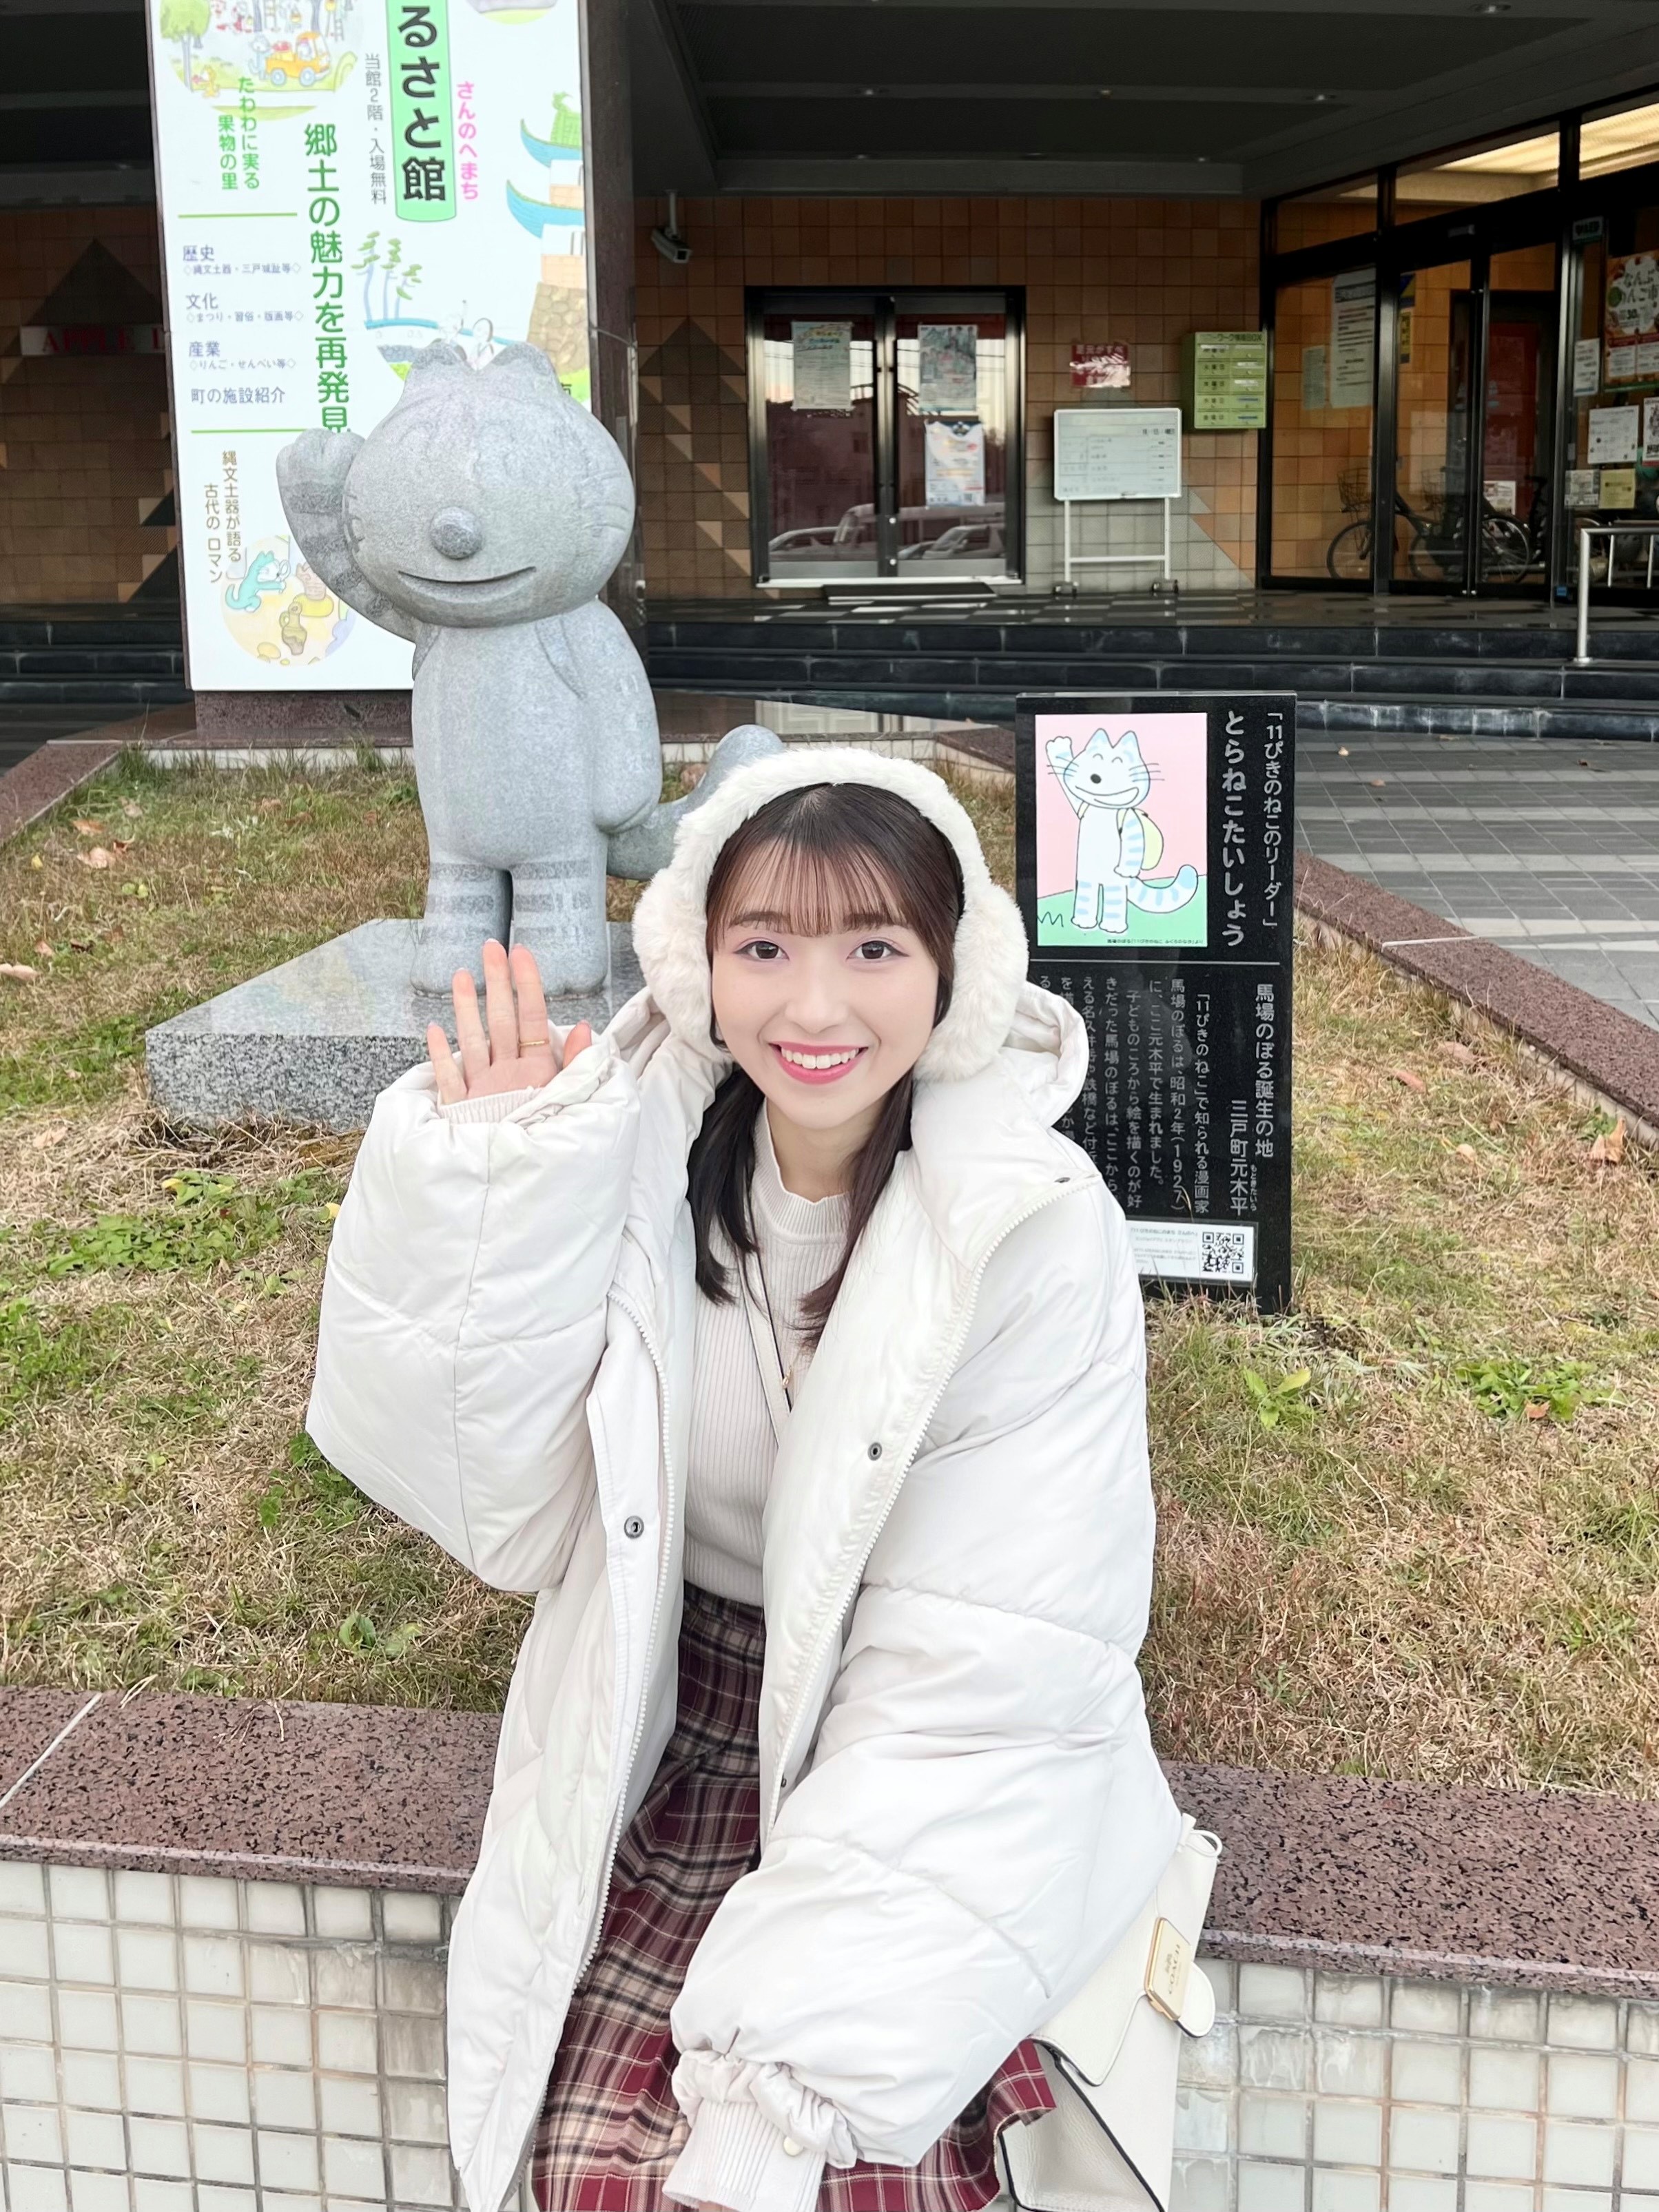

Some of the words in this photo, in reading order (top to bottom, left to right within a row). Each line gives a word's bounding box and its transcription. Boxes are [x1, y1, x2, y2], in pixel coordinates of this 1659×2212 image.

[218, 114, 238, 190] 果物の里
[238, 76, 260, 189] たわわに実る
[365, 53, 387, 205] 当館2階・入場無料
[398, 6, 446, 201] るさと館
[457, 81, 479, 200] さんのへまち
[183, 245, 215, 262] 歴史
[185, 292, 218, 310] 文化
[305, 123, 351, 433] 郷土の魅力を再発見
[188, 340, 220, 357] 産業
[191, 386, 286, 405] 町の施設紹介
[204, 483, 223, 583] 古代のロマン
[222, 450, 242, 563] 縄文土器が語る
[1222, 710, 1247, 947] とらねこたいしょう
[1262, 712, 1284, 928] 「11ぴきのねこのリーダー」
[1104, 977, 1120, 1199] きだった馬場のぼるは、ここから
[1126, 990, 1142, 1208] 子どものころから絵を描くのが好
[1148, 980, 1164, 1185] に、ここ元木平で生まれました。
[1194, 993, 1210, 1213] 「11ぴきのねこ」で知られる漫画家
[1255, 984, 1275, 1157] 馬場のぼる誕生の地
[1230, 1099, 1248, 1216] 三戸町元木平
